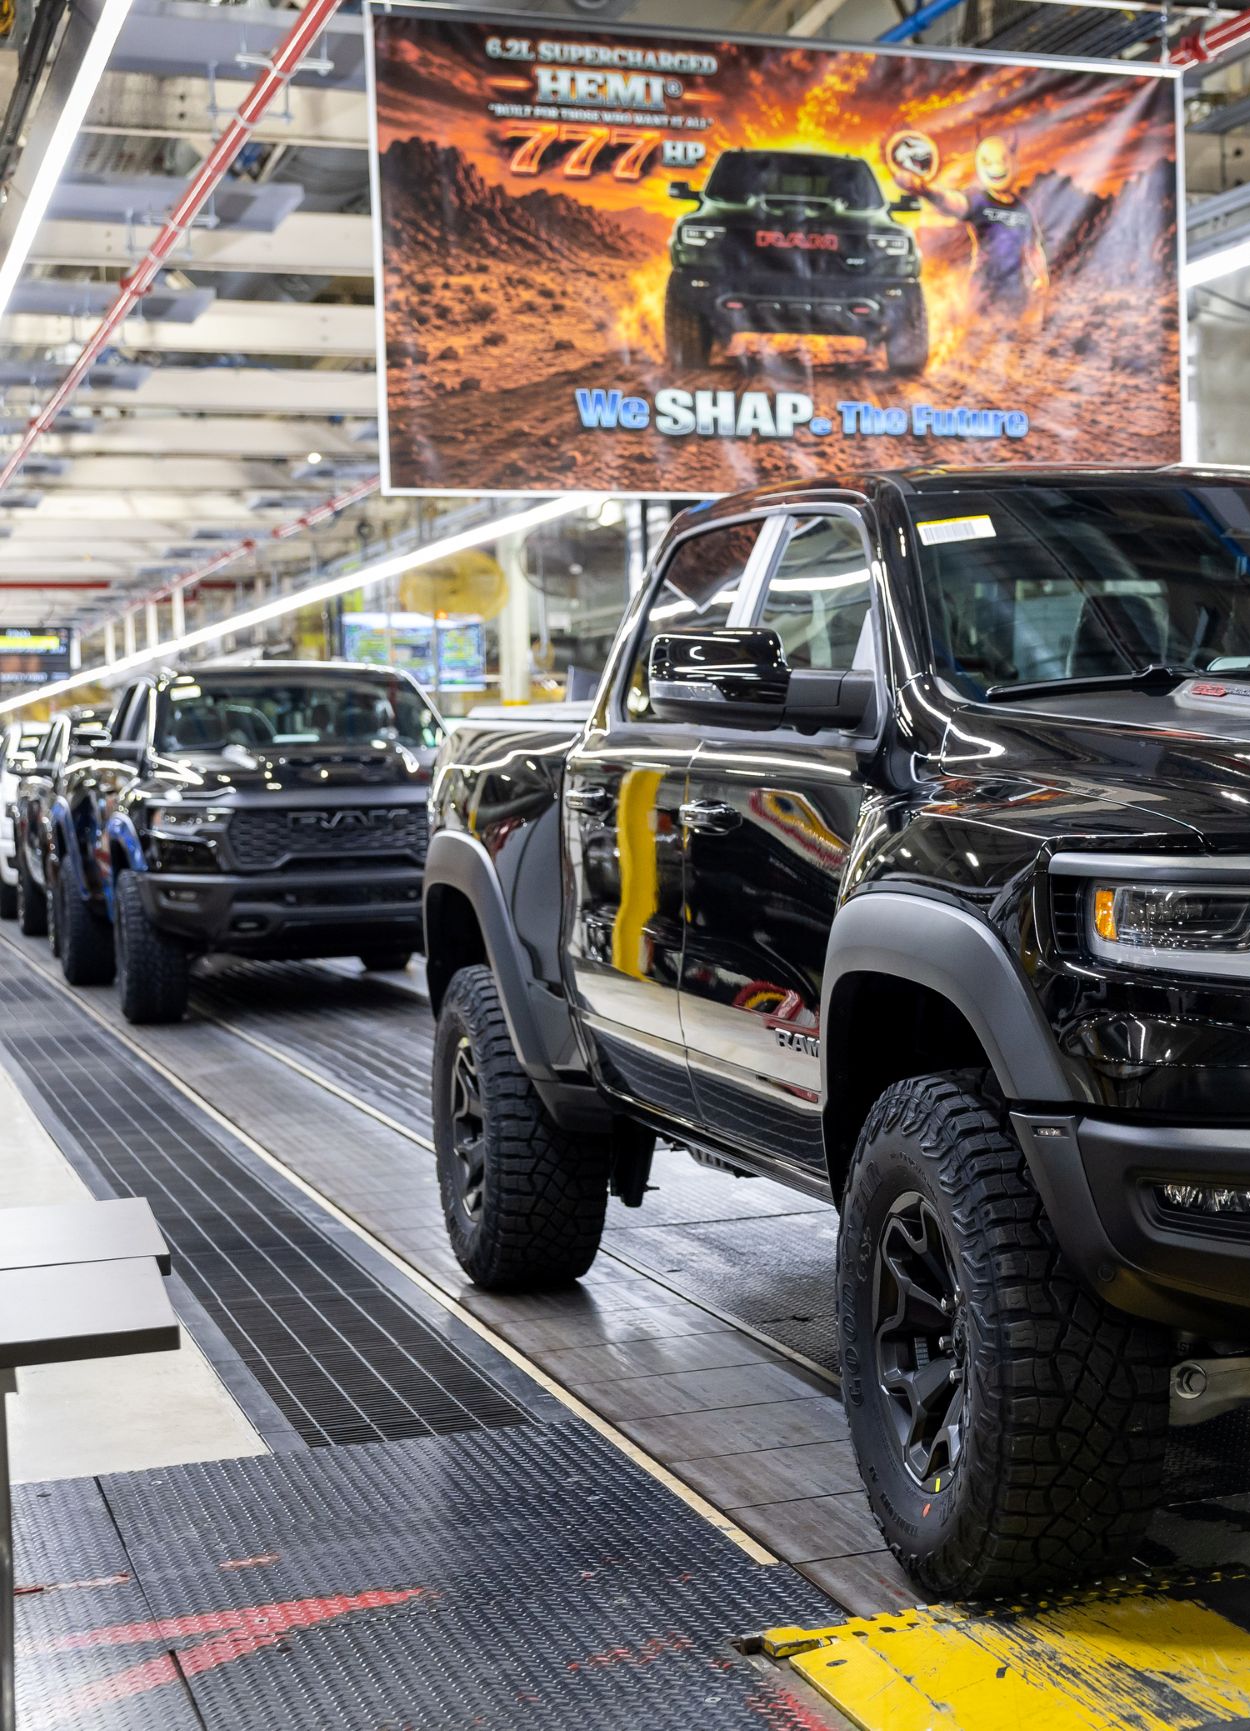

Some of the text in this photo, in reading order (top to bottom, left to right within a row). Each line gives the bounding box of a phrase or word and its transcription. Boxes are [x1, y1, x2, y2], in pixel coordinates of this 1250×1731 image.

[485, 36, 718, 75] 6.2L SUPERCHARGED
[502, 121, 706, 181] 777 HP
[575, 388, 650, 430] We
[837, 400, 907, 435] The
[911, 403, 1030, 438] Future
